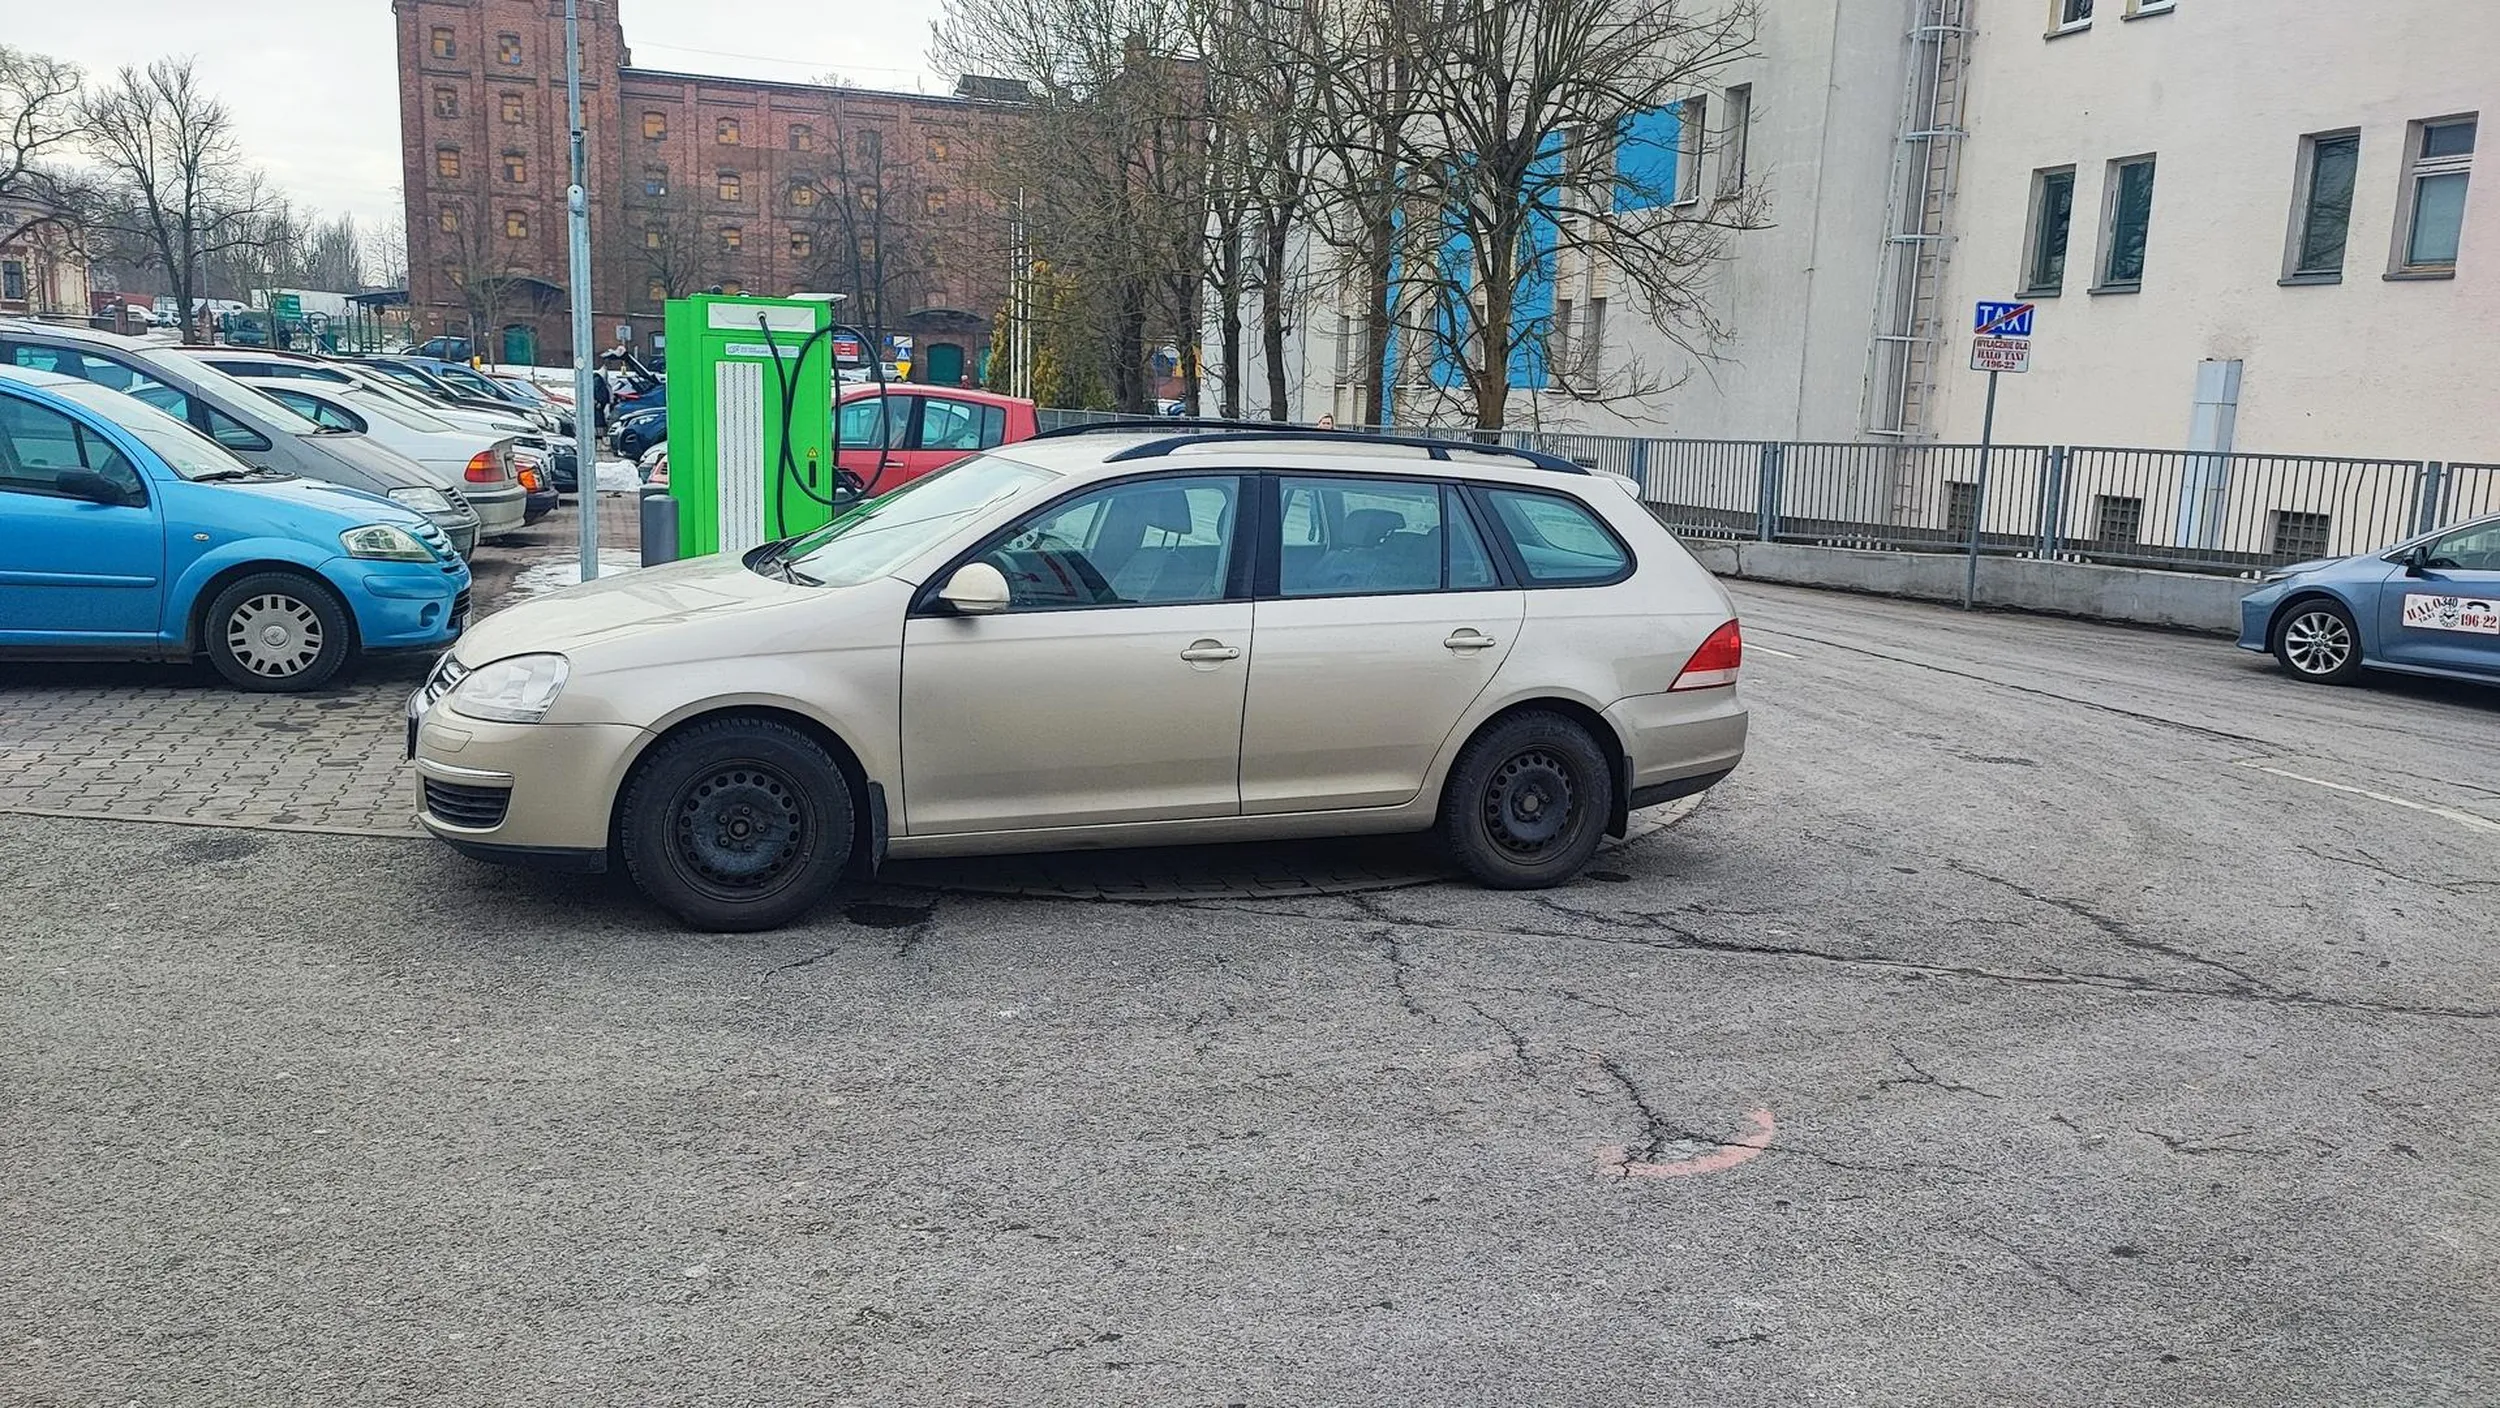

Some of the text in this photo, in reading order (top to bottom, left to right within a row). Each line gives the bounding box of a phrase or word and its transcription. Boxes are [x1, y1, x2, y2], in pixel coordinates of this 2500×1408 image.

[1980, 306, 2029, 331] TAXI
[1977, 350, 2025, 360] HALO TAXI
[2407, 598, 2441, 620] HALO
[2441, 596, 2458, 608] 340
